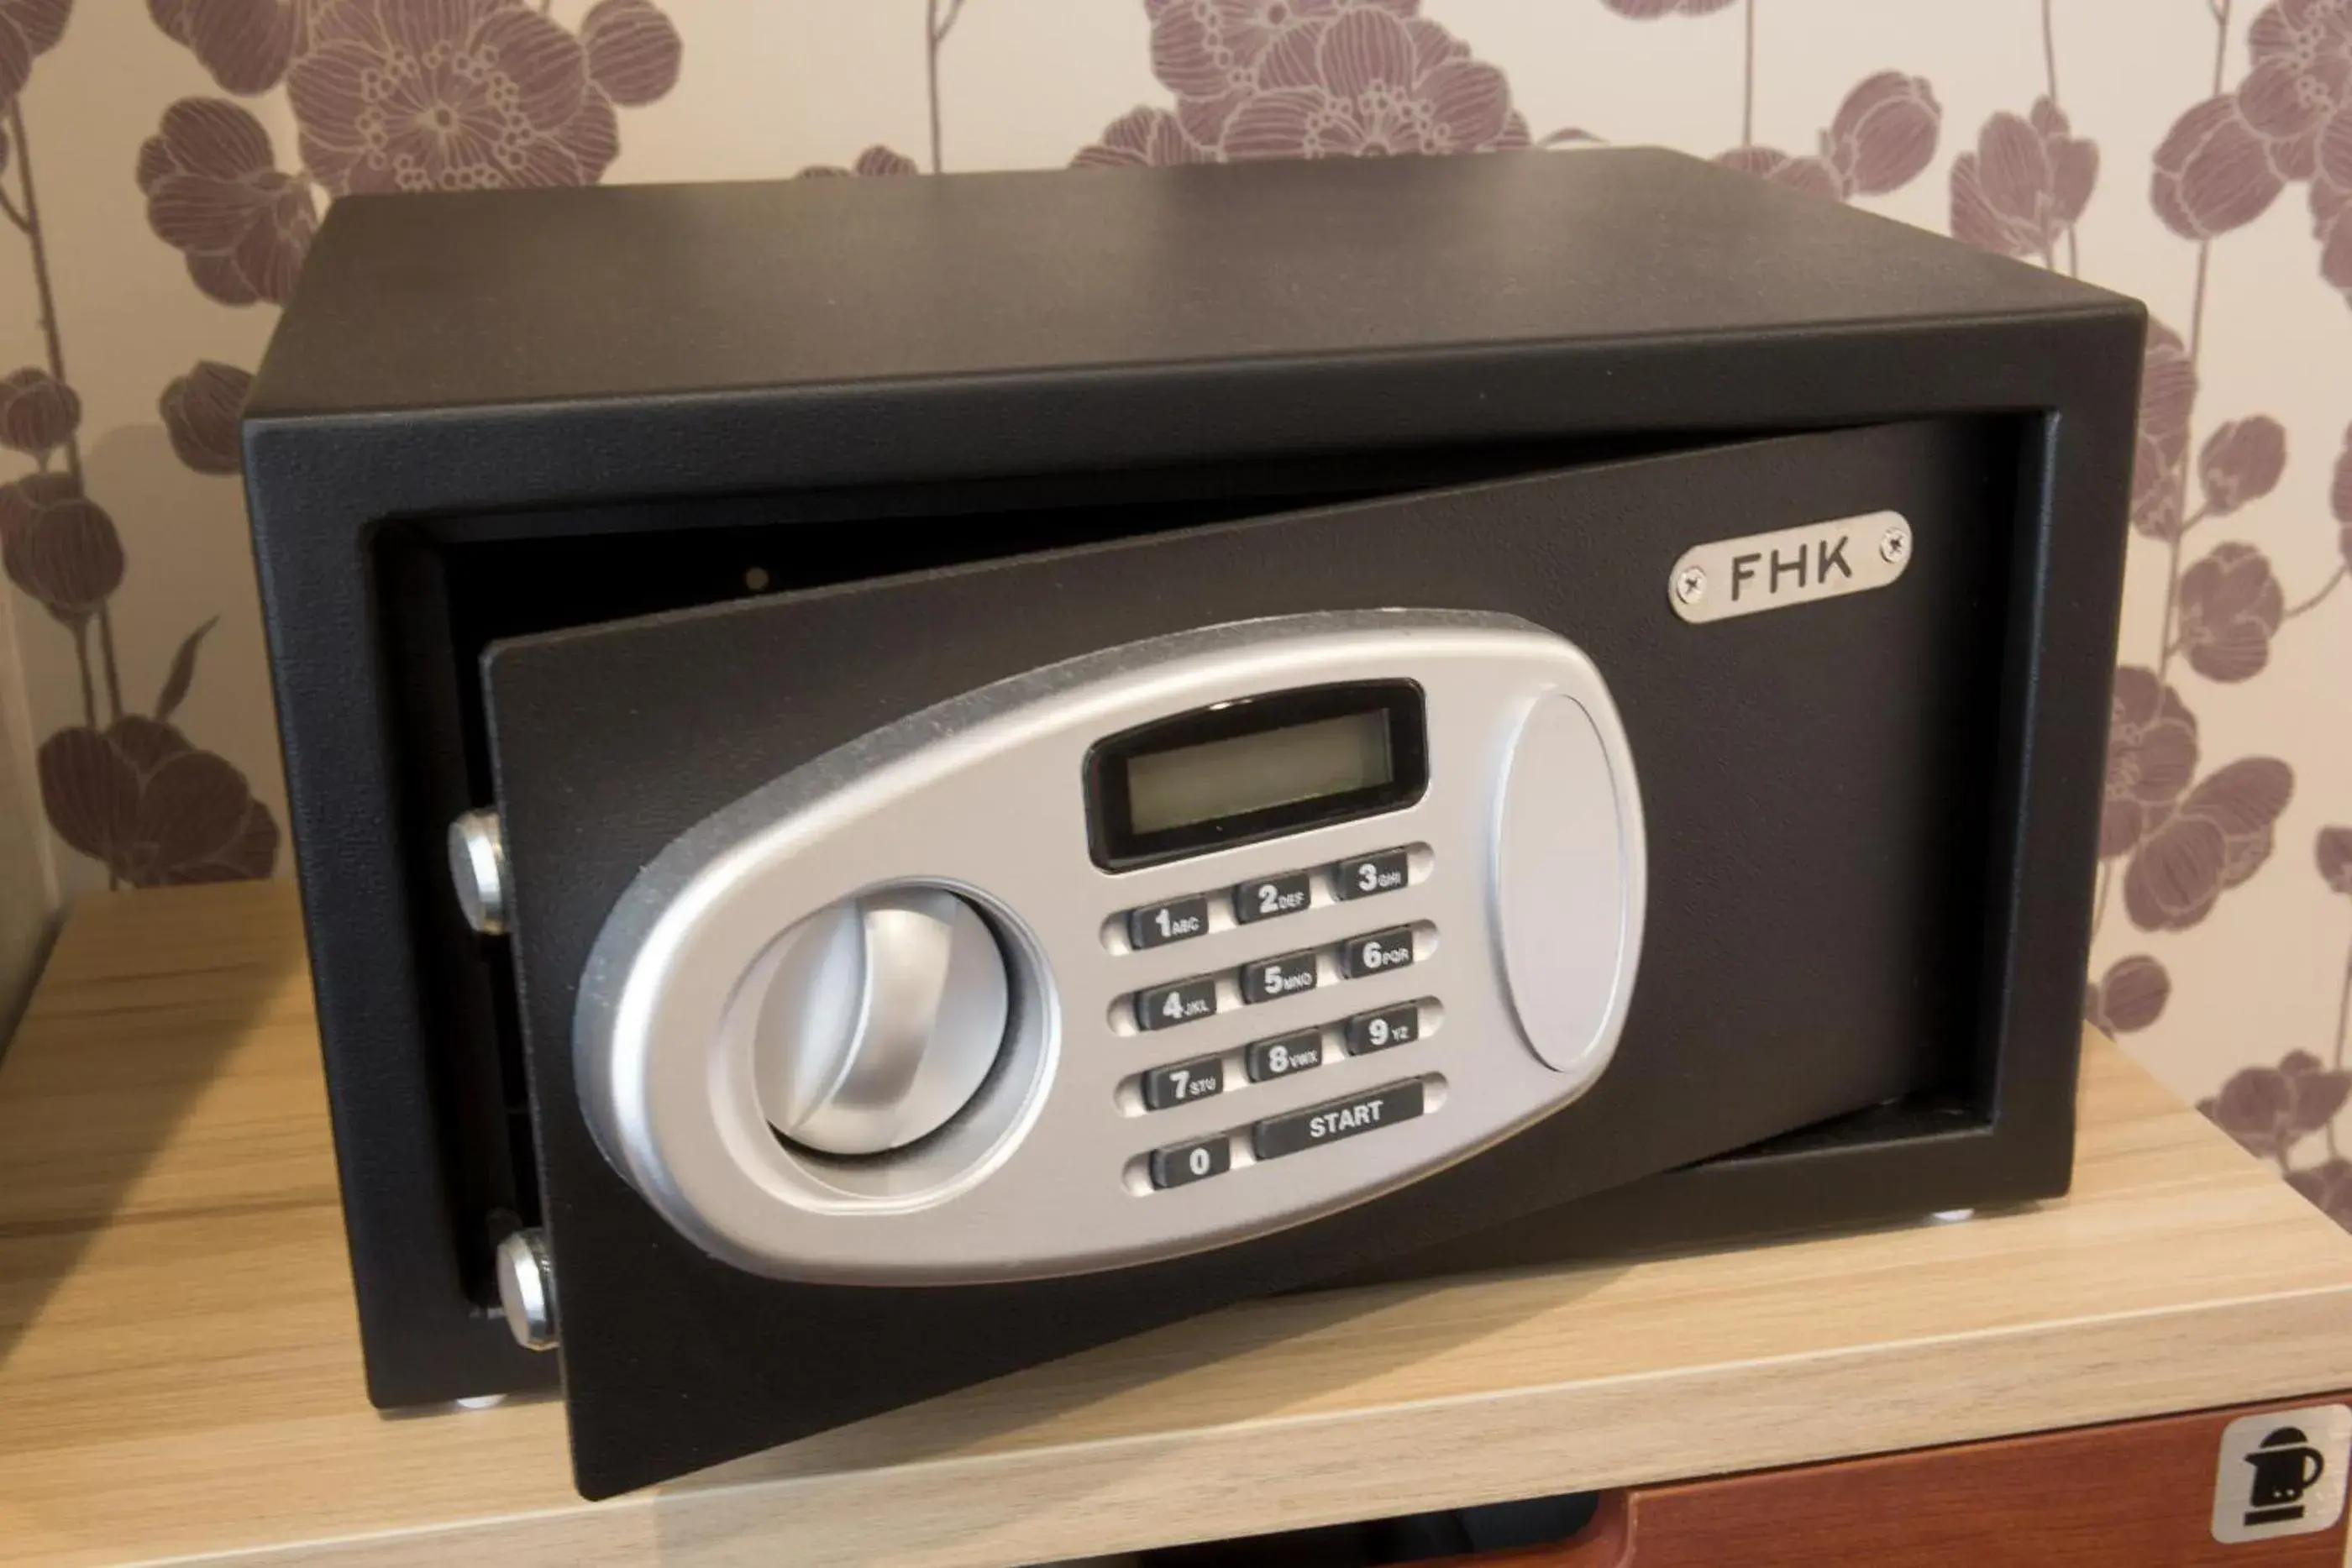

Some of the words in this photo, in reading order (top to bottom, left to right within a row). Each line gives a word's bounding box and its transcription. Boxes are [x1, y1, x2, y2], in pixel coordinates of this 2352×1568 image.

[1732, 536, 1851, 601] FHK
[1358, 863, 1378, 891] 3
[1259, 884, 1279, 913] 2
[1155, 908, 1171, 937] 1
[1362, 941, 1383, 968] 6
[1264, 966, 1284, 994] 5
[1163, 991, 1183, 1019] 4
[1368, 1019, 1389, 1046] 9
[1268, 1045, 1289, 1072] 8
[1169, 1070, 1190, 1099] 7
[1310, 1100, 1383, 1138] START
[1189, 1148, 1210, 1175] 0
